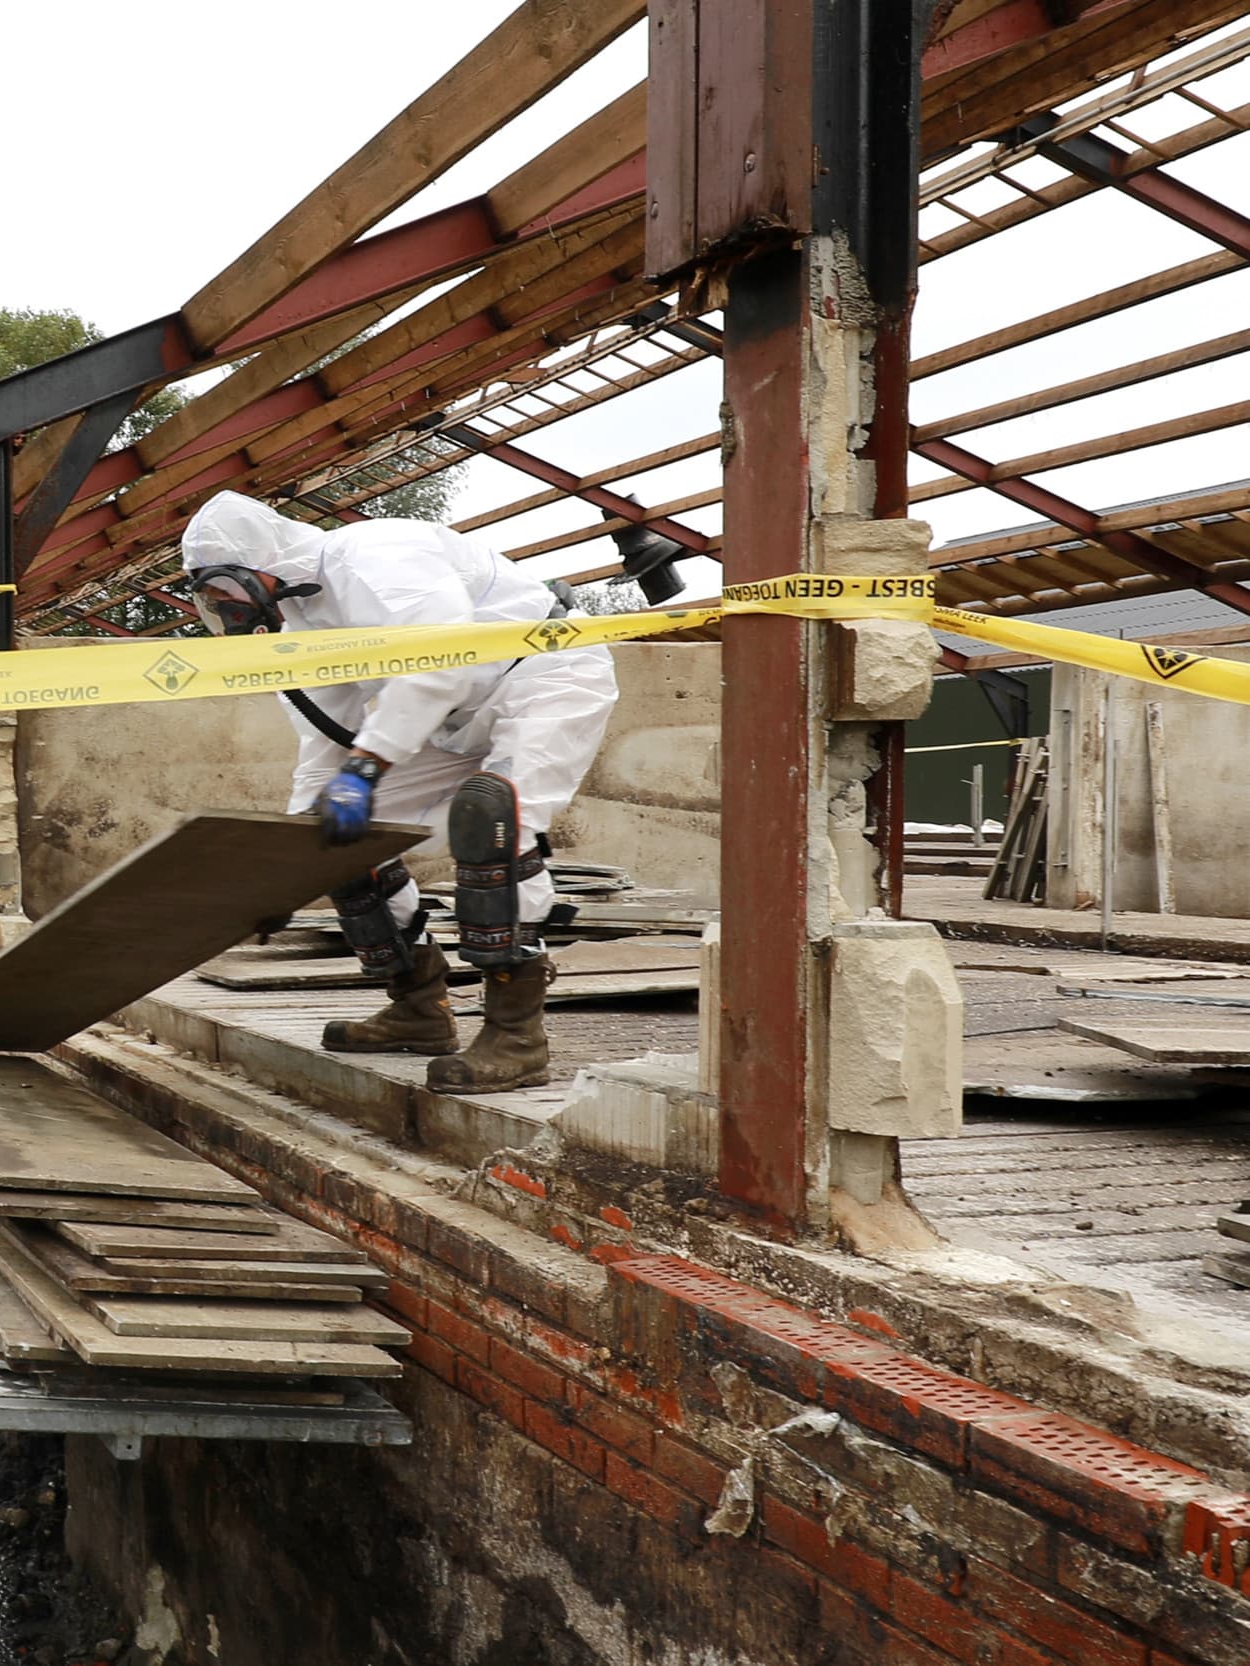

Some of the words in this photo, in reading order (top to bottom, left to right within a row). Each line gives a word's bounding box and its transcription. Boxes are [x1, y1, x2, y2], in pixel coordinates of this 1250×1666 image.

[723, 585, 780, 601] TOEGAN
[785, 579, 844, 598] GEEN
[866, 579, 935, 598] SBEST
